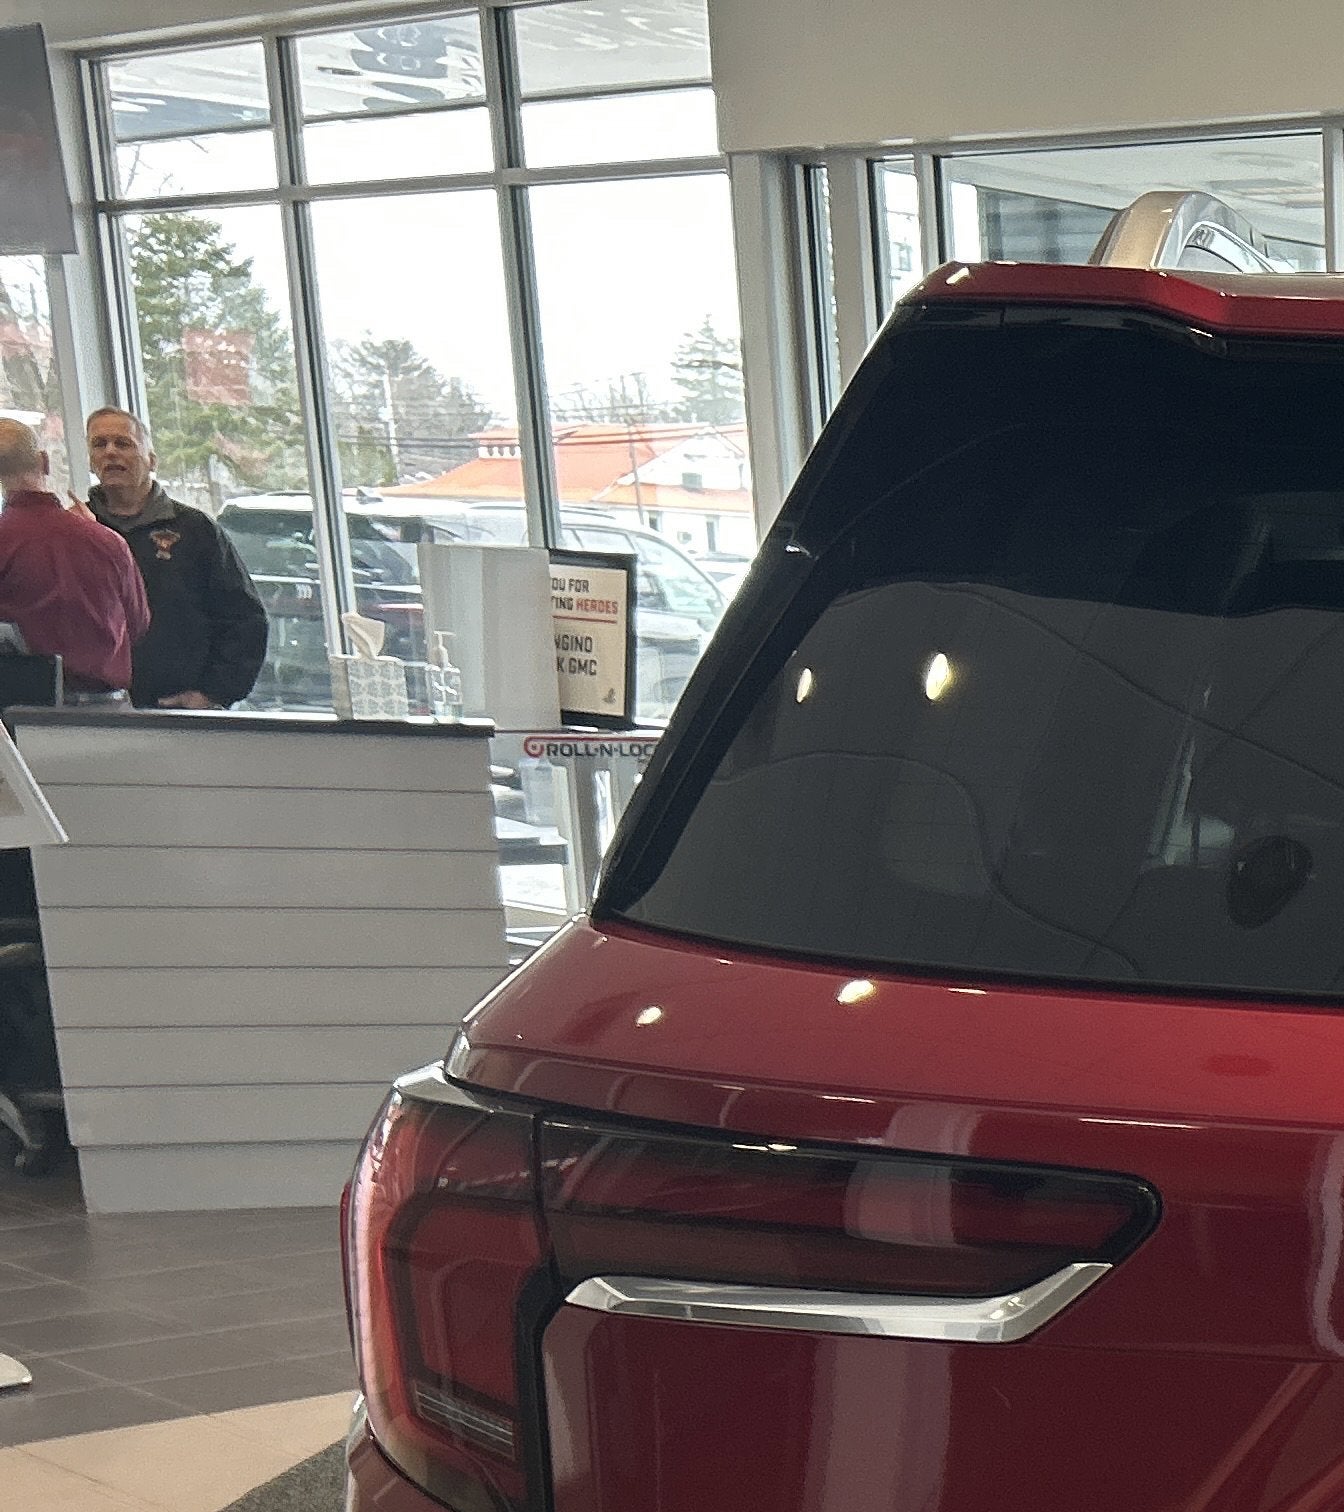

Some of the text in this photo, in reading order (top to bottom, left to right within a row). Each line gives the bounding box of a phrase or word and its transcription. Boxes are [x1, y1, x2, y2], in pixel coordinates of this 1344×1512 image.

[551, 577, 590, 593] OU FOR
[576, 597, 619, 615] HEROES
[568, 657, 597, 676] GMC
